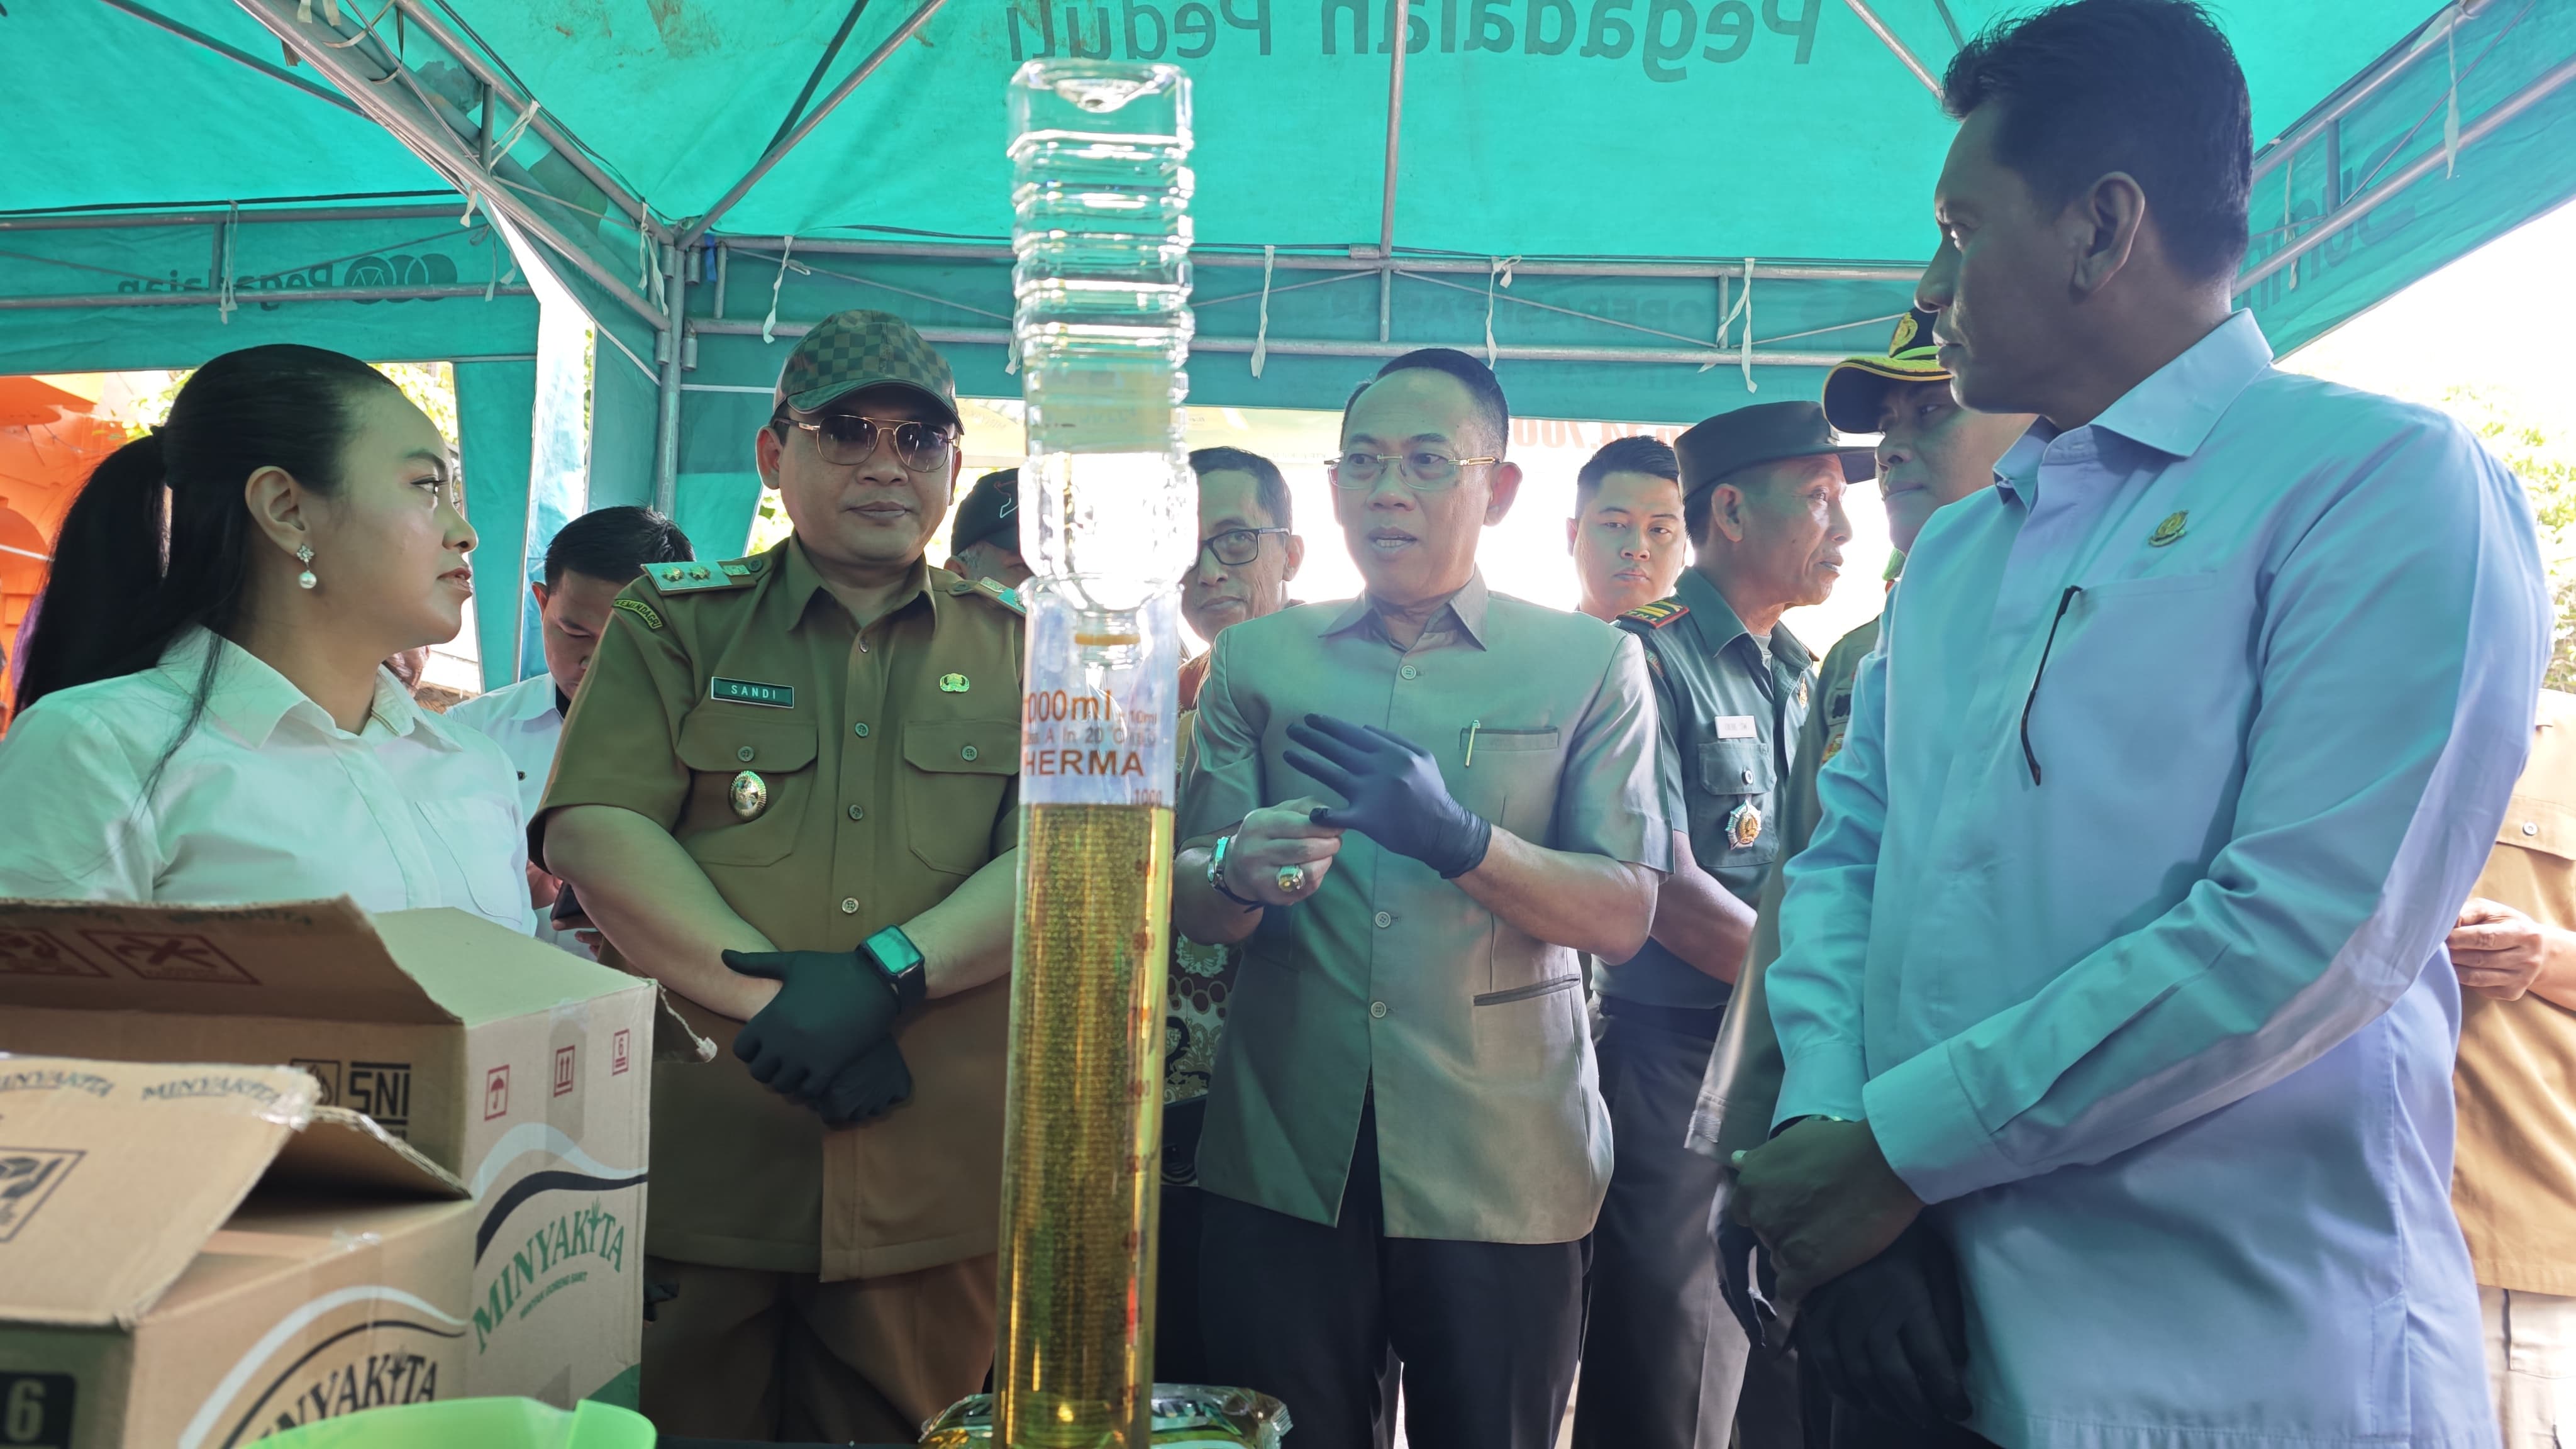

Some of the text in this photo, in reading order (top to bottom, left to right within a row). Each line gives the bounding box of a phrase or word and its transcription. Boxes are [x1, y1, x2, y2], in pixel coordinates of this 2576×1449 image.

[731, 684, 776, 700] SANDI
[1024, 750, 1144, 777] HERMA
[616, 1036, 625, 1056] 6
[349, 1070, 410, 1116] SNI
[472, 1197, 625, 1356] MINYAKITA
[5, 1378, 47, 1443] 6
[257, 1347, 438, 1439] NYAKITA
